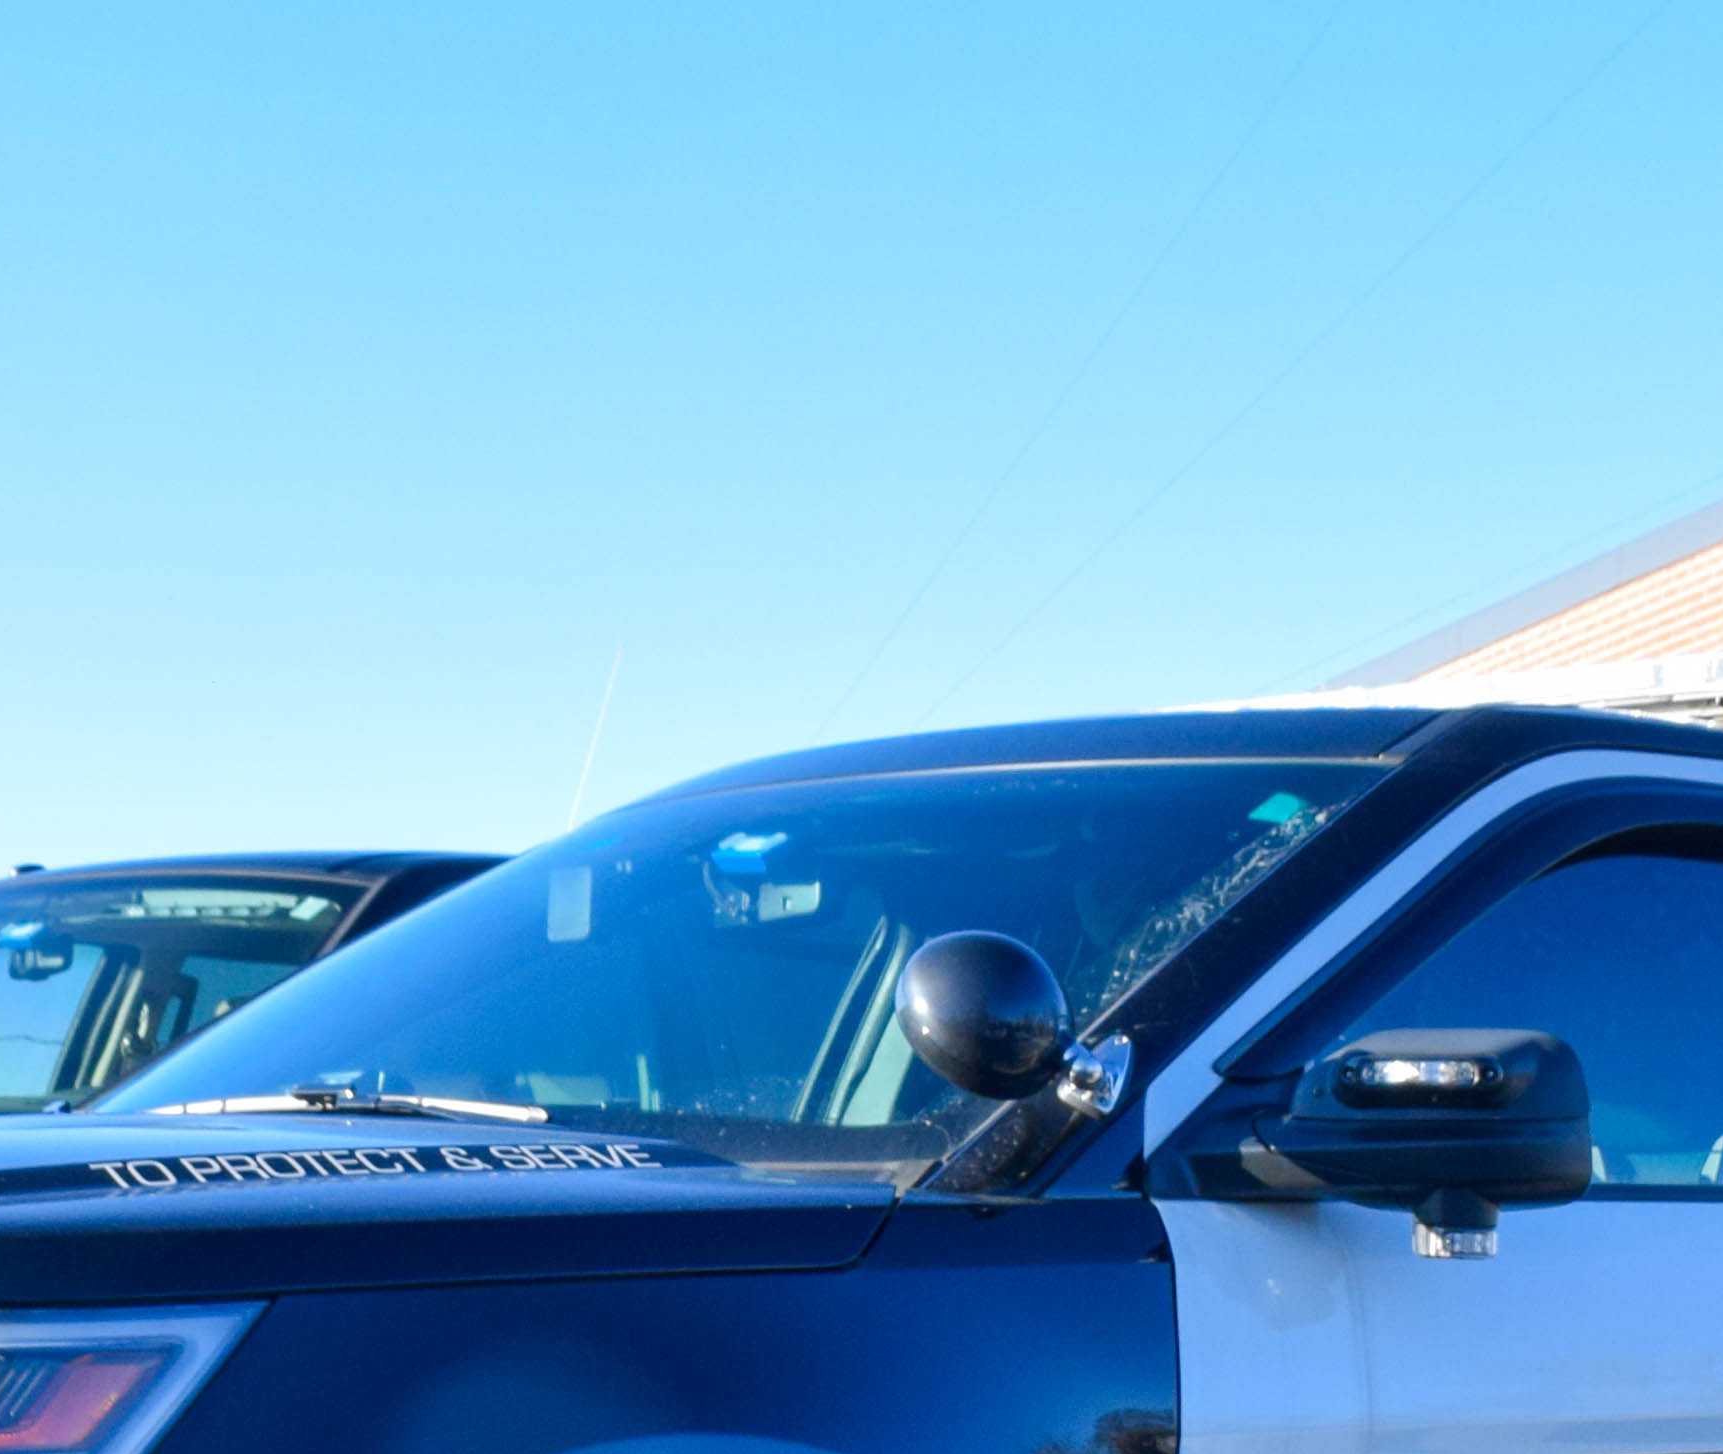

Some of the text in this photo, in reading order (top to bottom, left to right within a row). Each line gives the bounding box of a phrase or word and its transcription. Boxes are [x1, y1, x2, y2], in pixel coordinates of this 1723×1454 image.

[89, 1144, 663, 1189] TO PROTECT & SERVE
